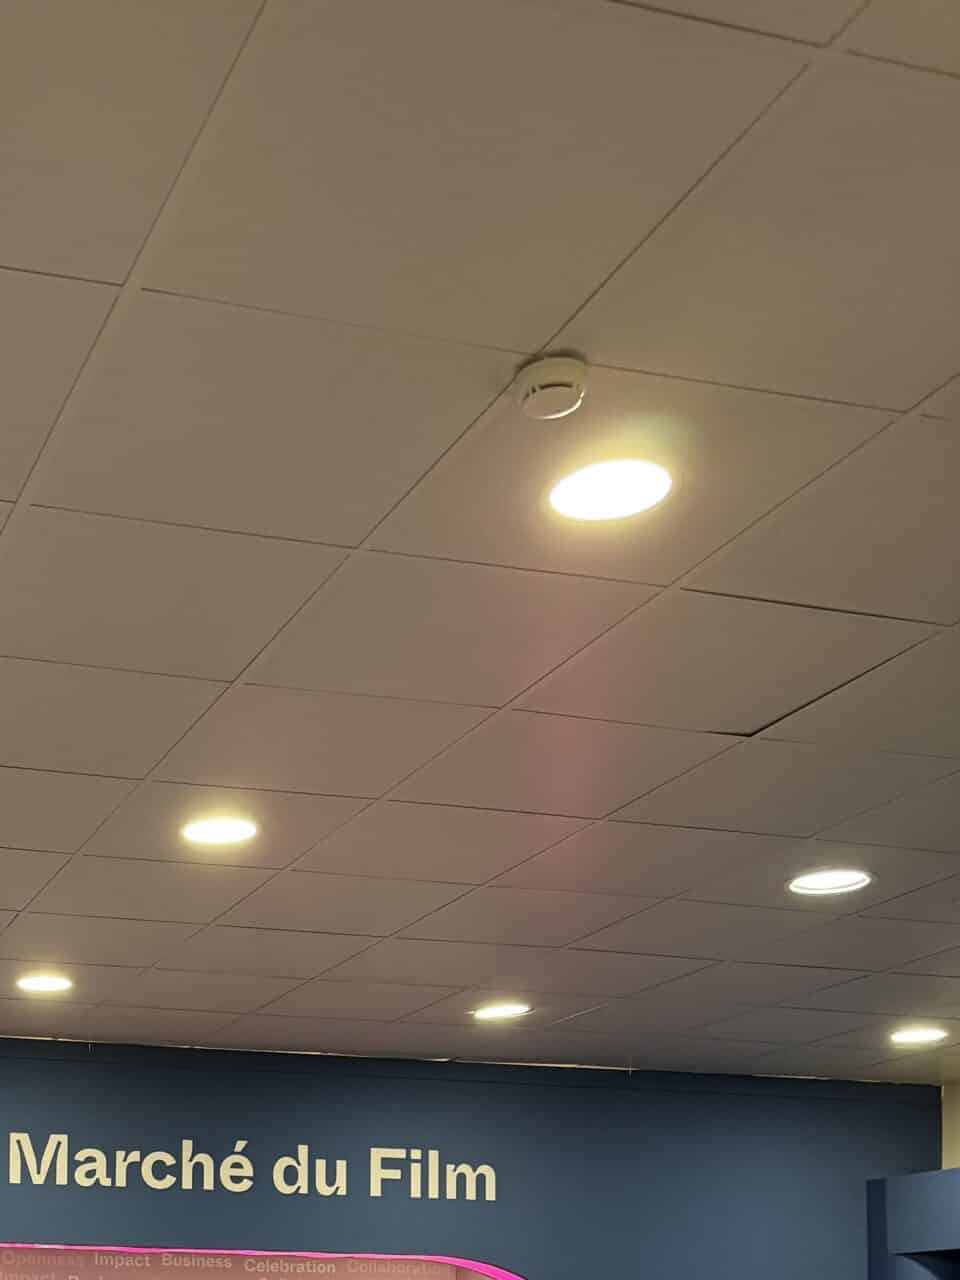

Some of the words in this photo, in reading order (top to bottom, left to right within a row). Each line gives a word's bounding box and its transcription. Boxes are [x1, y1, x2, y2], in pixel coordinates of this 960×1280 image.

[8, 1132, 254, 1193] Marché
[272, 1144, 347, 1196] du
[369, 1147, 496, 1201] Film
[95, 1253, 151, 1271] Impact
[161, 1254, 233, 1270] Business
[244, 1259, 336, 1275] Celebration
